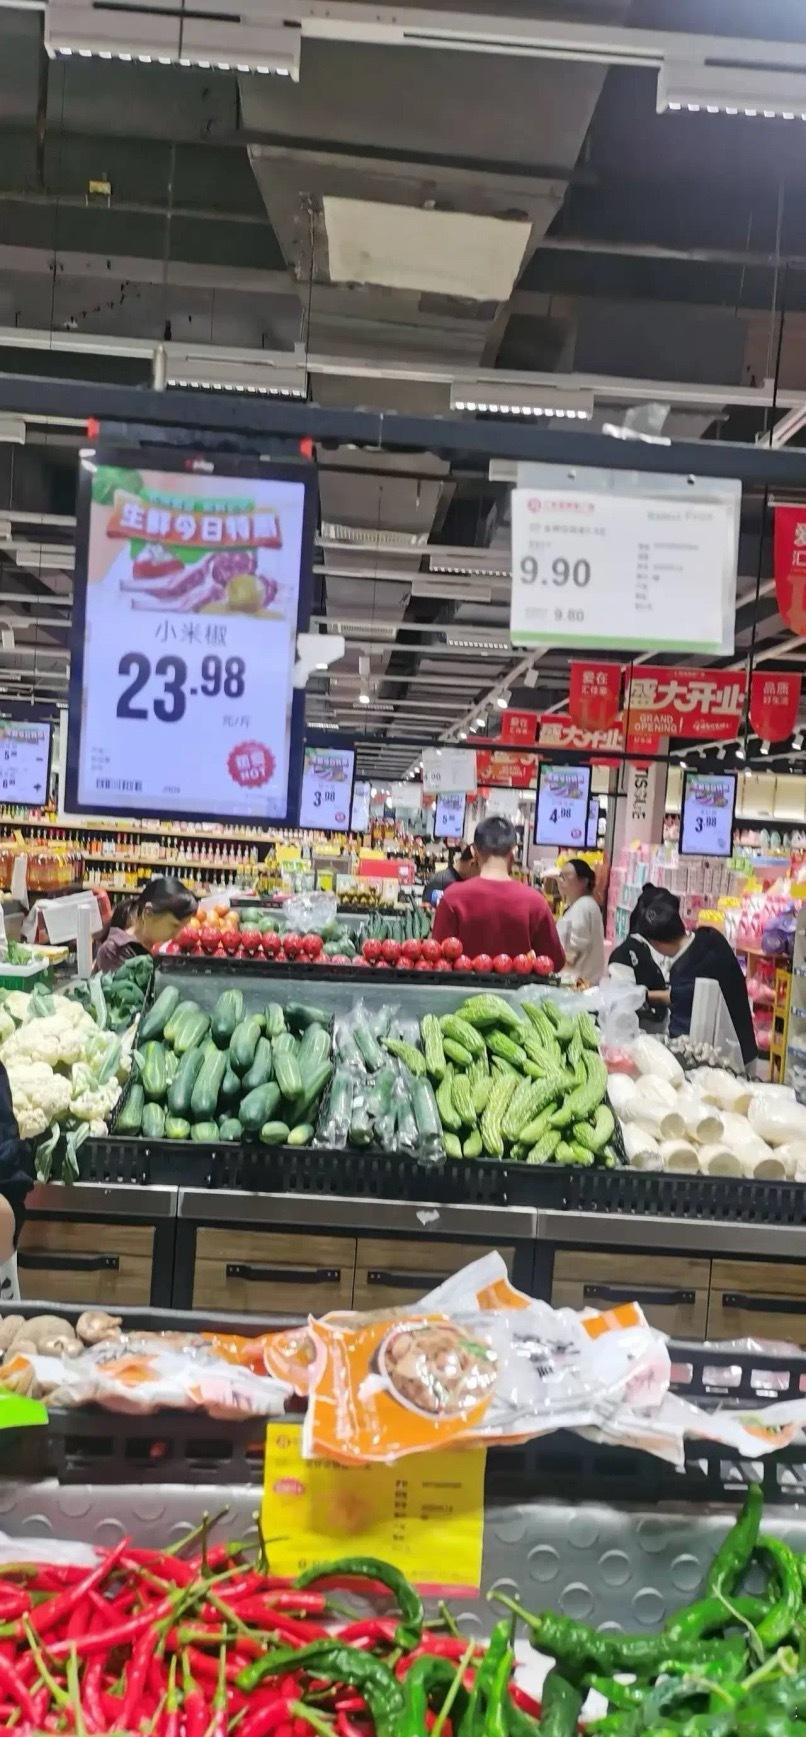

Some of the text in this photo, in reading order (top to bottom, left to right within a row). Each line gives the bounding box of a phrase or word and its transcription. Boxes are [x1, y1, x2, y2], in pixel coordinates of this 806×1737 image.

[519, 555, 591, 588] 9.90
[154, 619, 228, 647] 小米椒
[582, 670, 608, 685] 爱在
[116, 651, 246, 723] 23.98
[763, 681, 789, 696] 品质
[624, 678, 745, 717] 盛大开业
[639, 713, 674, 724] GRAND
[241, 766, 266, 781] HOT
[549, 808, 571, 823] 4.98
[695, 816, 717, 832] 3.98
